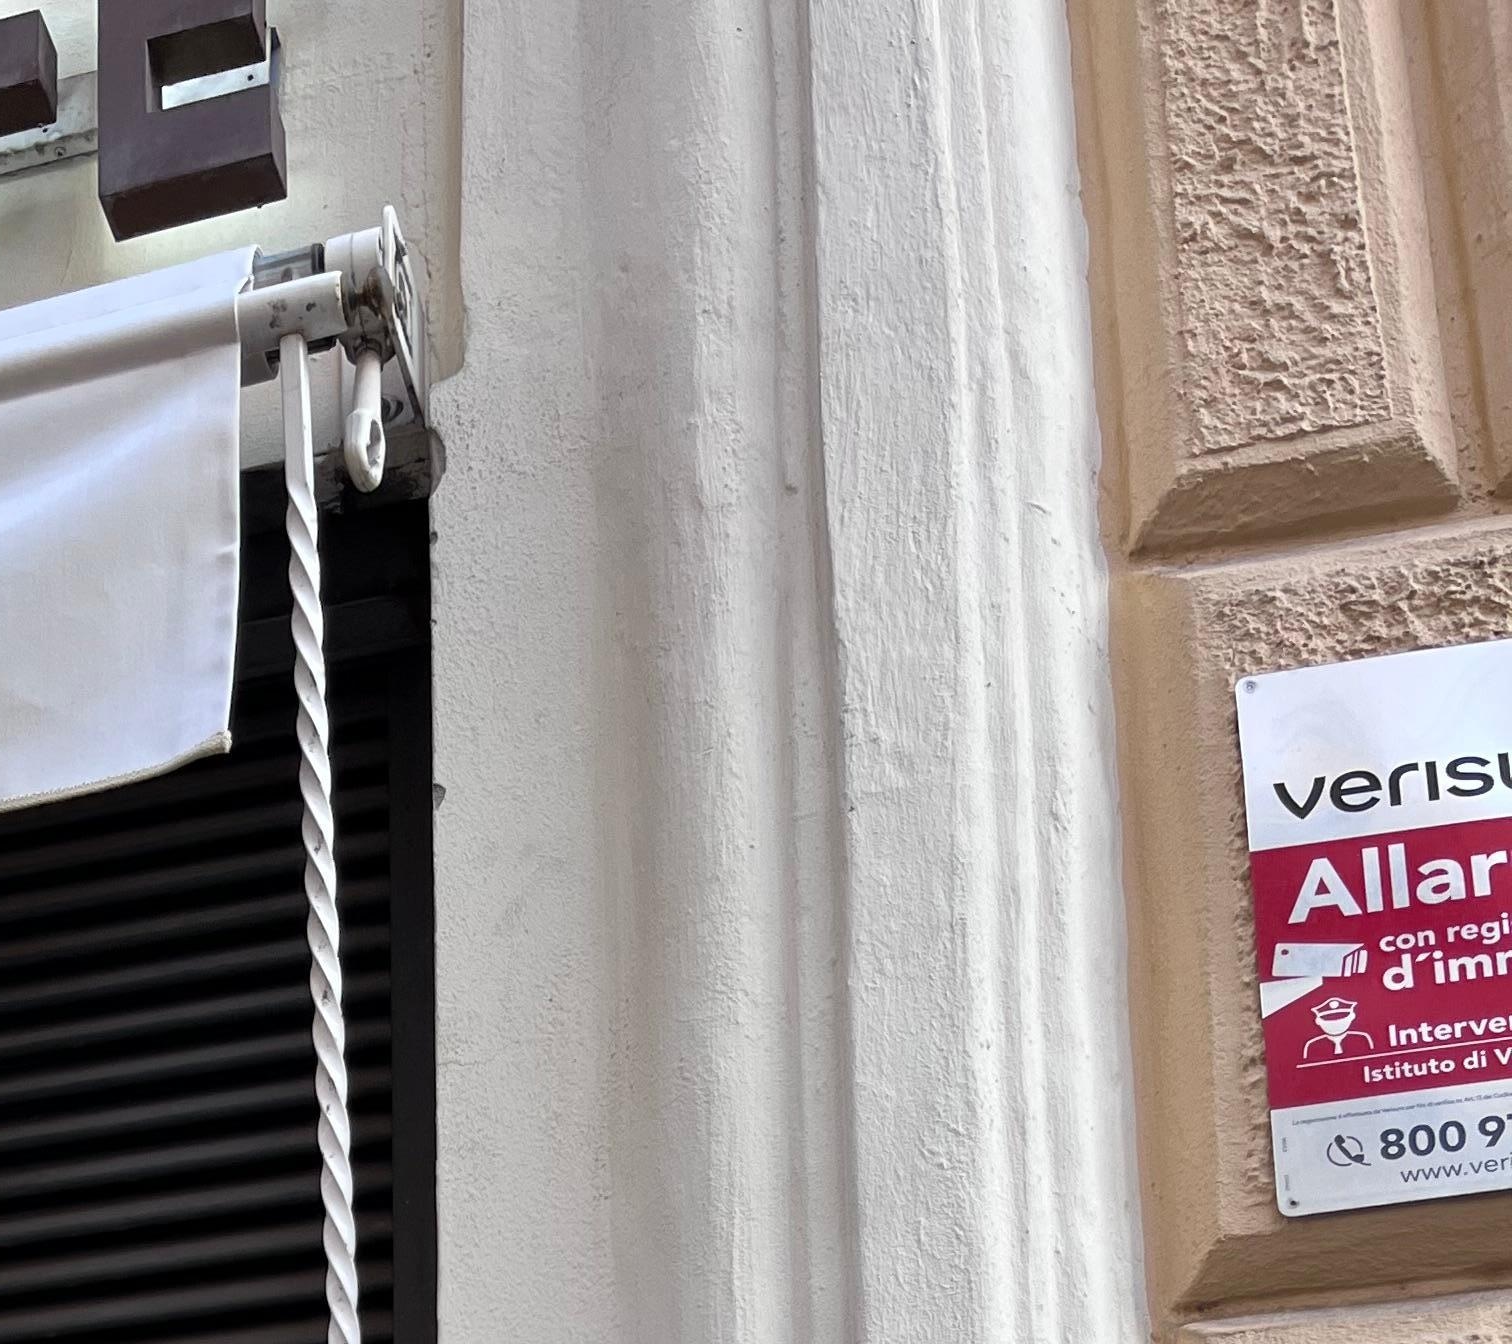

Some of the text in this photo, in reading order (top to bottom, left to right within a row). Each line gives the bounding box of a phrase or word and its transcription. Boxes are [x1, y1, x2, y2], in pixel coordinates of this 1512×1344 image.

[1379, 929, 1436, 952] con
[1363, 1056, 1456, 1083] Istituto
[1463, 1050, 1487, 1070] di
[1379, 1120, 1467, 1161] 800
